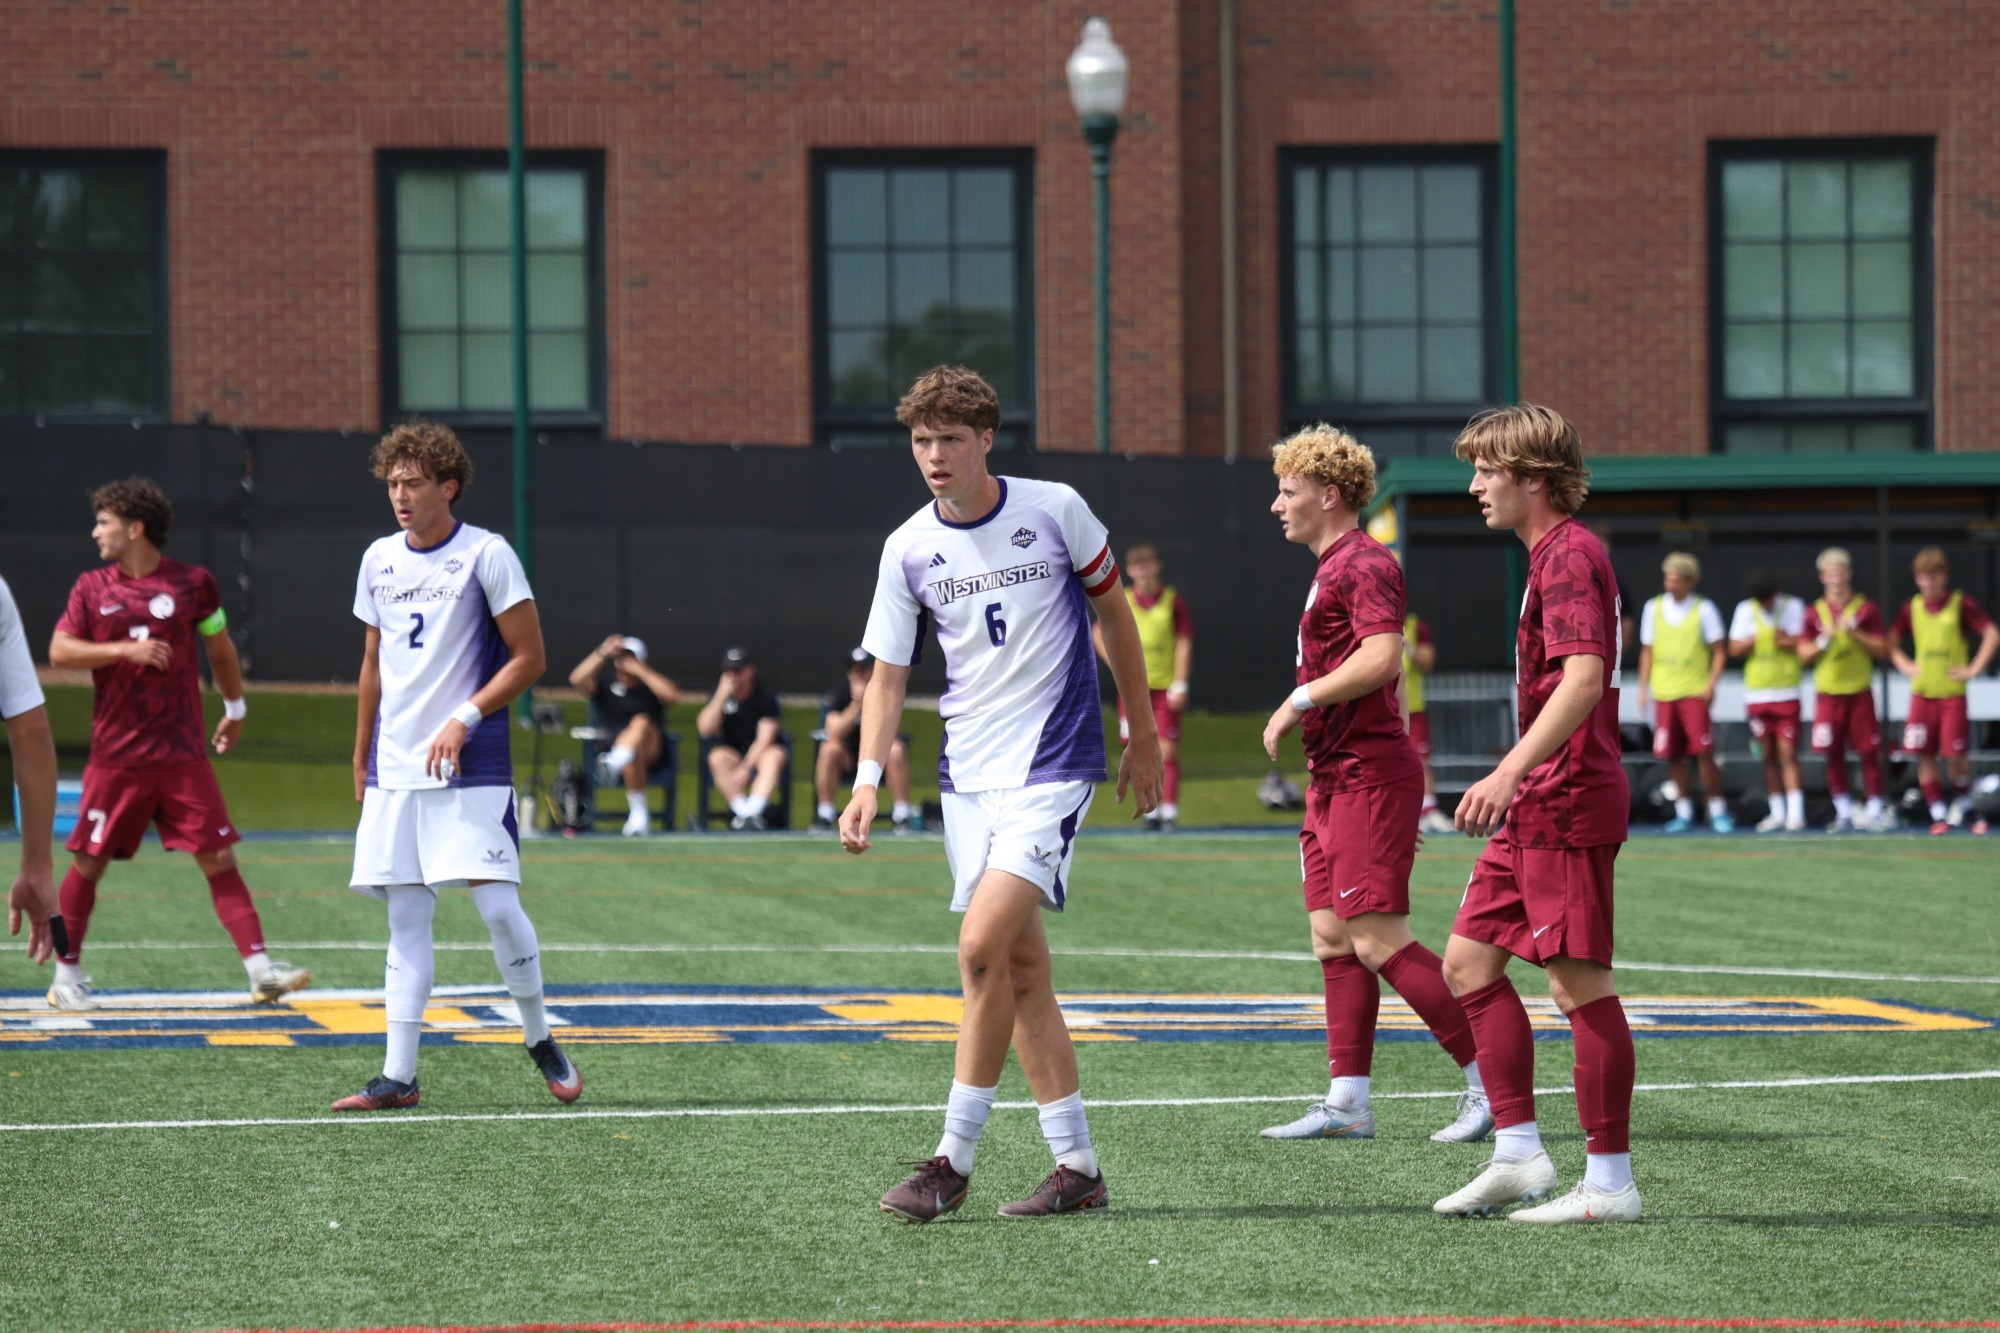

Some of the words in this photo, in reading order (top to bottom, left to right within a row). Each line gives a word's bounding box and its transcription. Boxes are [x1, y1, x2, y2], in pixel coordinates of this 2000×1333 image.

[1012, 532, 1036, 545] RMAC
[409, 612, 424, 649] 2
[985, 602, 1006, 648] 6
[87, 808, 107, 844] 7
